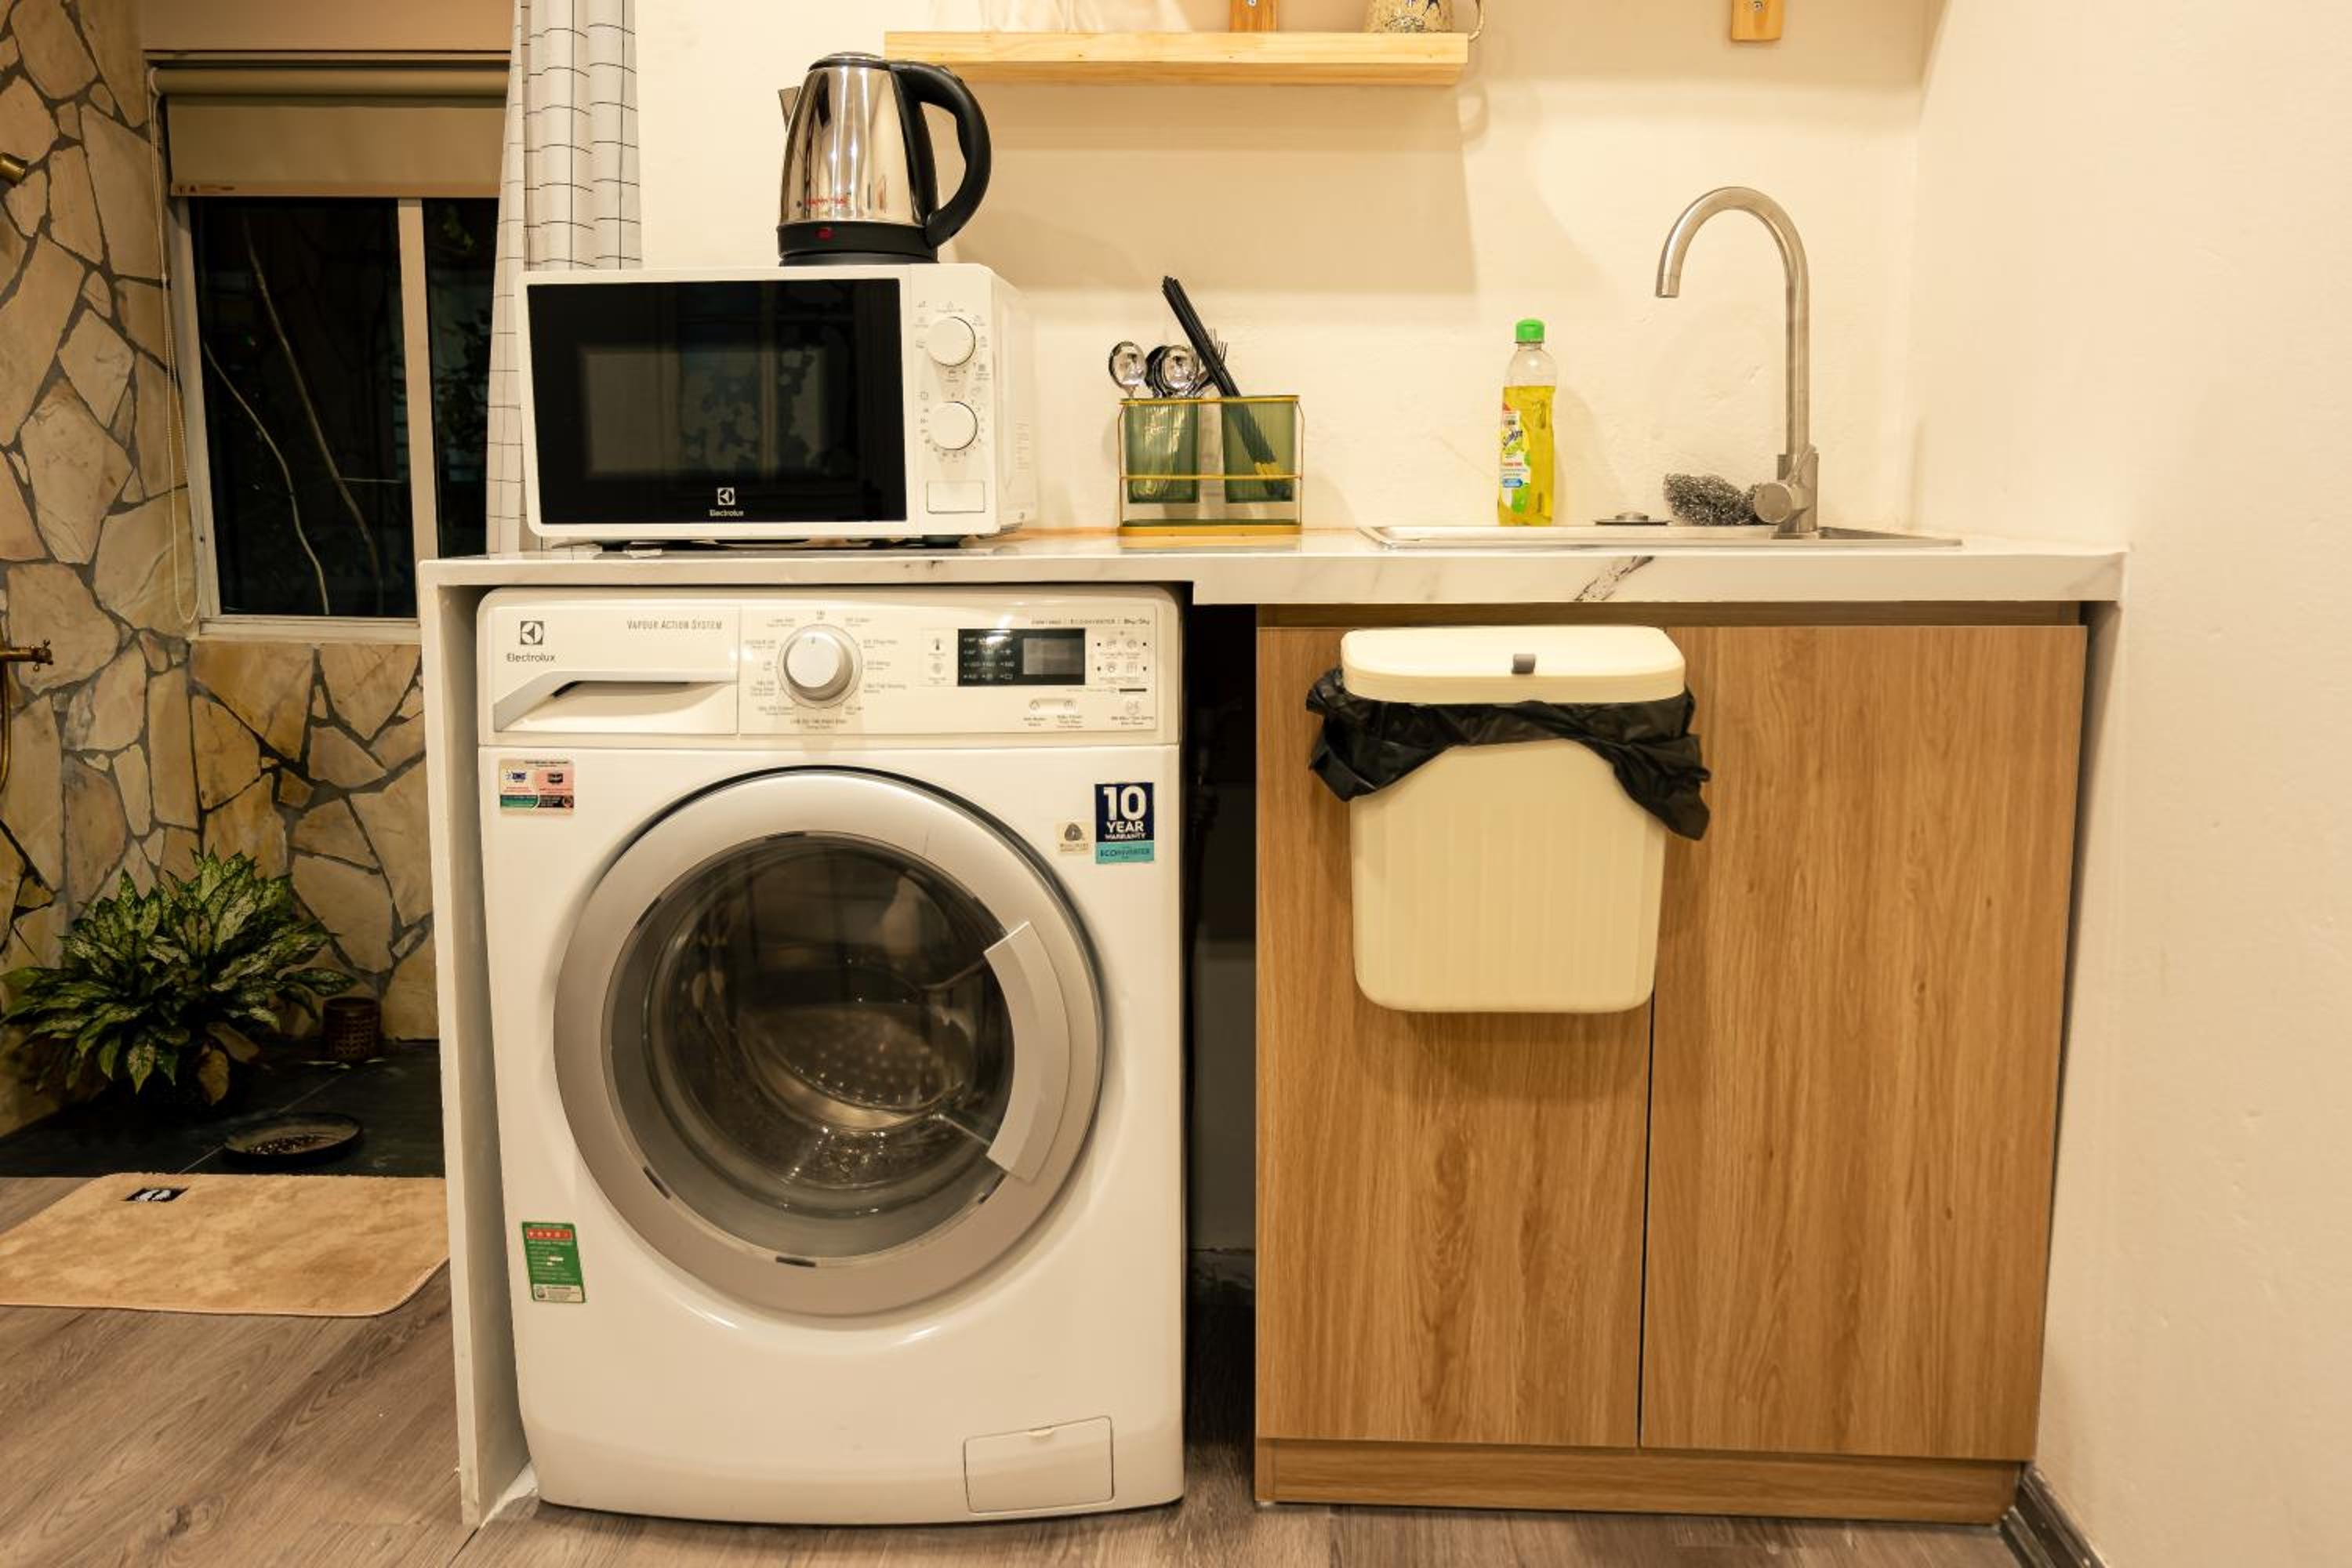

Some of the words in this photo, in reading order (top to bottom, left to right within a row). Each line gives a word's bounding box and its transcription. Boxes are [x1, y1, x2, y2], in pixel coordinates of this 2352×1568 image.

[626, 619, 659, 630] VAPOUR
[661, 619, 689, 630] ACTION
[691, 619, 723, 630] SYSTEM
[506, 652, 555, 662] Electrolux
[1103, 786, 1147, 821] 10
[1106, 822, 1145, 833] YEAR
